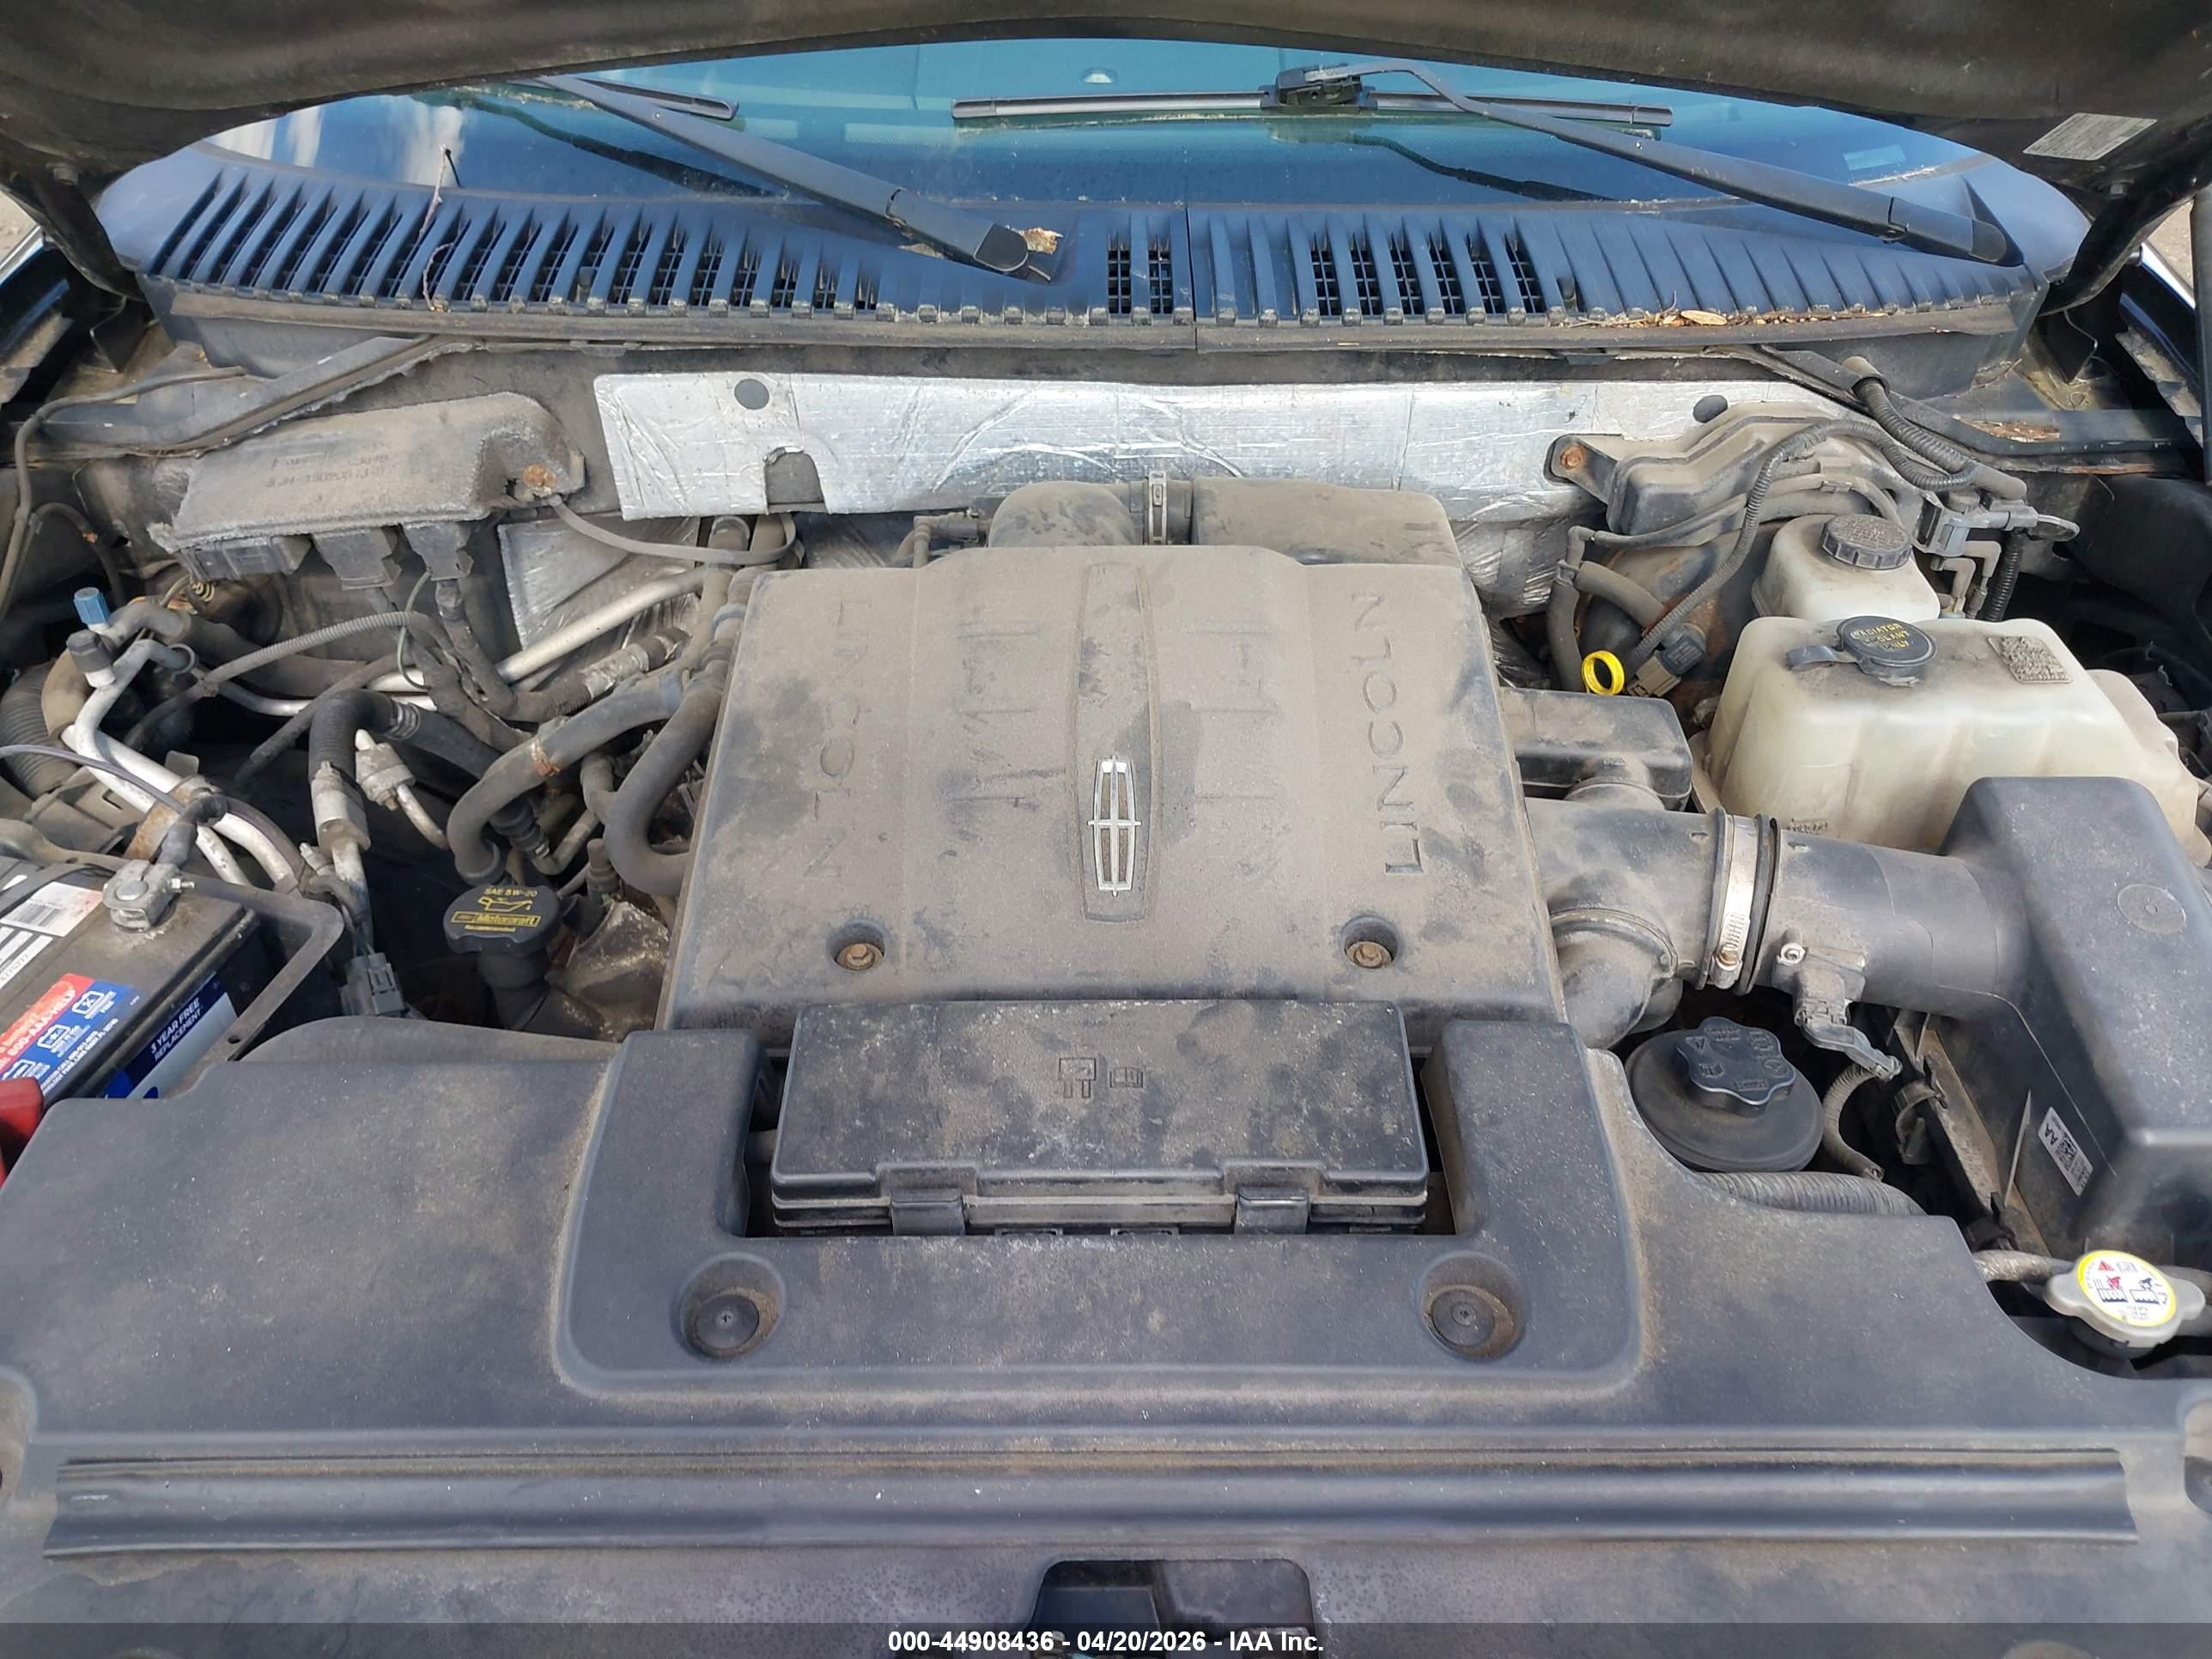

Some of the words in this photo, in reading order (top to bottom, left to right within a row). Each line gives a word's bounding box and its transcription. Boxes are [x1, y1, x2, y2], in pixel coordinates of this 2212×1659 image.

[1351, 592, 1424, 873] LINCOLN
[484, 887, 504, 896] SAE
[476, 913, 536, 926] Motorcraft
[150, 1042, 157, 1054] 3
[156, 1020, 179, 1046] YEAR
[178, 997, 200, 1024] FREE
[155, 1008, 202, 1061] REPLACEMENT
